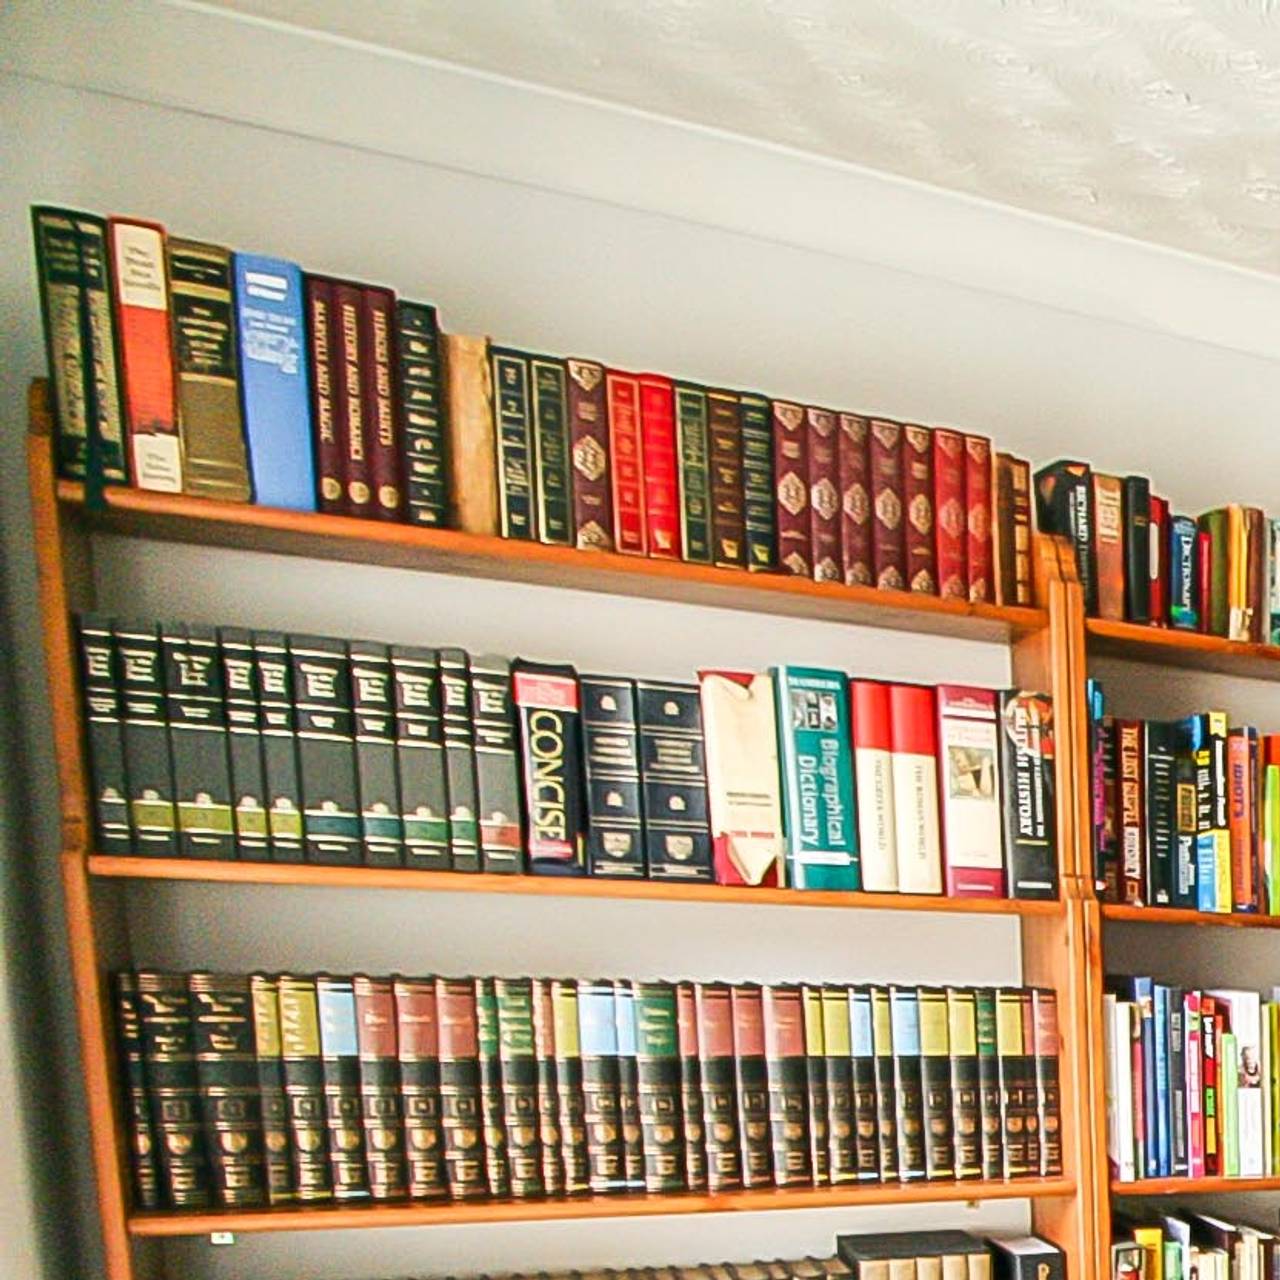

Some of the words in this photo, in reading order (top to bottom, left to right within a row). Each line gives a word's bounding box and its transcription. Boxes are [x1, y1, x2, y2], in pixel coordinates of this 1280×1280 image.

[316, 364, 330, 395] AND
[347, 363, 360, 395] AND
[376, 364, 390, 396] AND
[1180, 536, 1194, 613] DICTIONARY
[530, 711, 565, 841] CONCISE
[797, 755, 820, 846] Dictionary
[820, 738, 846, 845] Biographical
[1016, 772, 1034, 837] HISTORY
